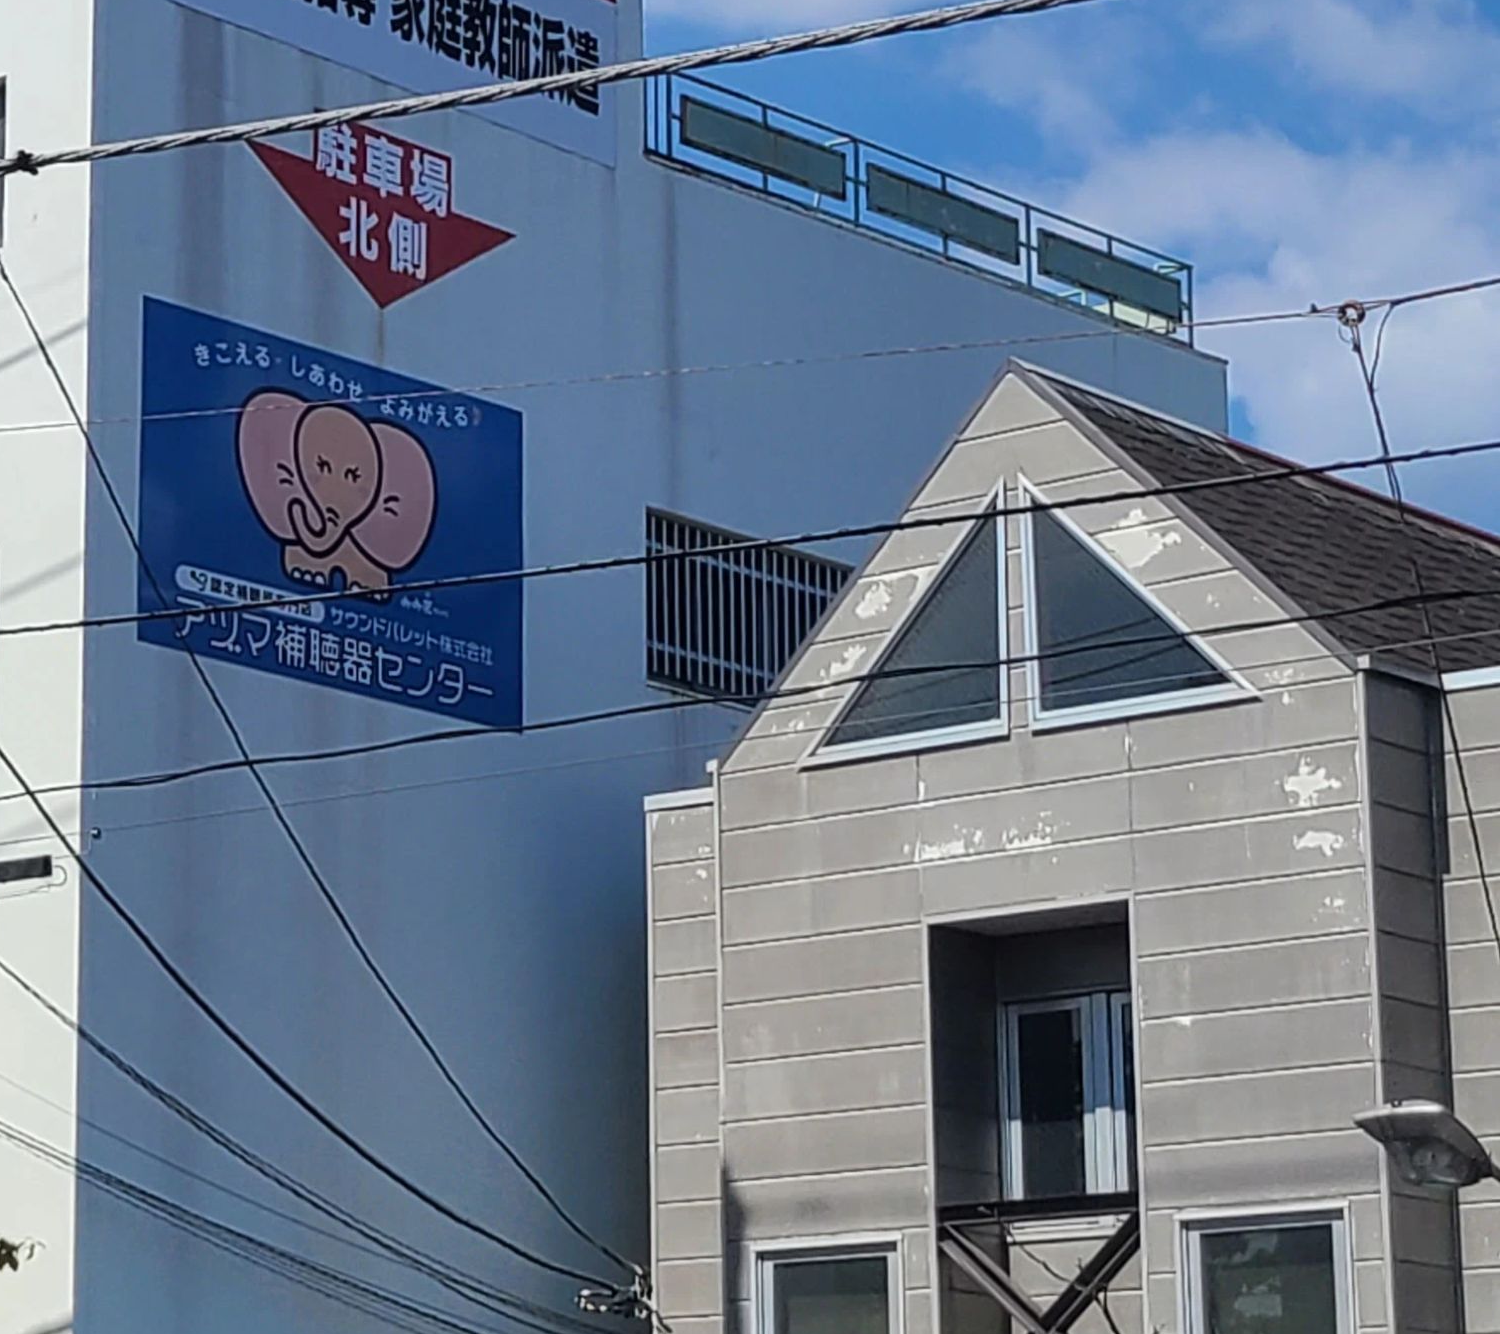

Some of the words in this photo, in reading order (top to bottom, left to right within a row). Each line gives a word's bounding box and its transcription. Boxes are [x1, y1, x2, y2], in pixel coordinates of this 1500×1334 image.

[313, 126, 451, 218] 駐車場
[338, 197, 429, 281] 北側
[290, 354, 363, 403] しあわせ
[379, 396, 470, 429] よみがえる
